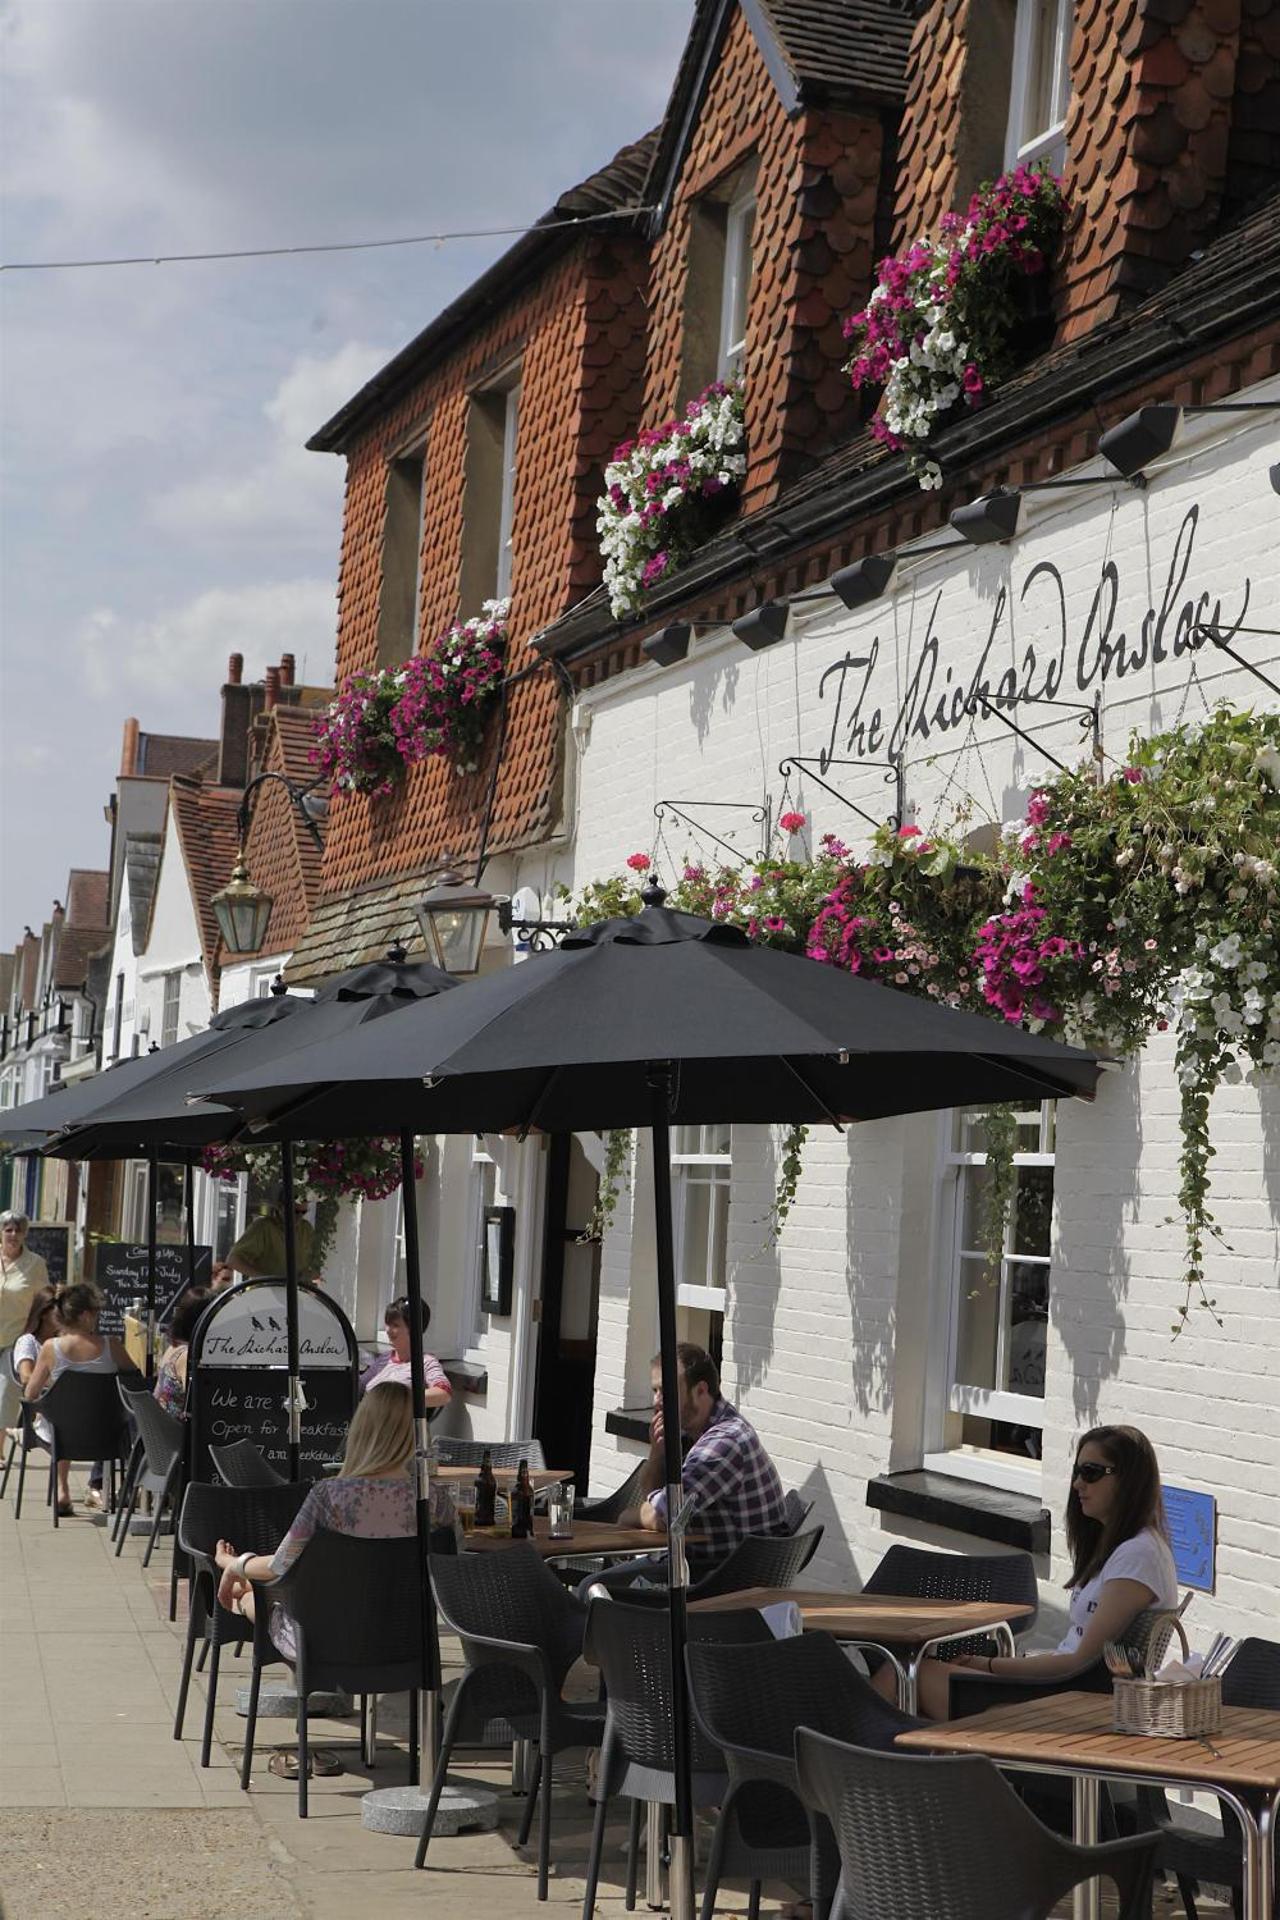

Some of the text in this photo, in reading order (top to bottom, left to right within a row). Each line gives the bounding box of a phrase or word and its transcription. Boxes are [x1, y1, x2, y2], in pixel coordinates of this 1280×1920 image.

[819, 503, 1250, 777] The Richard Onslow
[106, 1265, 139, 1280] Sunday
[160, 1265, 181, 1284] July
[207, 1334, 344, 1356] The Richar Onslow
[211, 1388, 238, 1408] We
[244, 1396, 272, 1410] are
[211, 1420, 253, 1440] Open
[260, 1420, 280, 1435] for
[299, 1448, 342, 1464] eekdays
